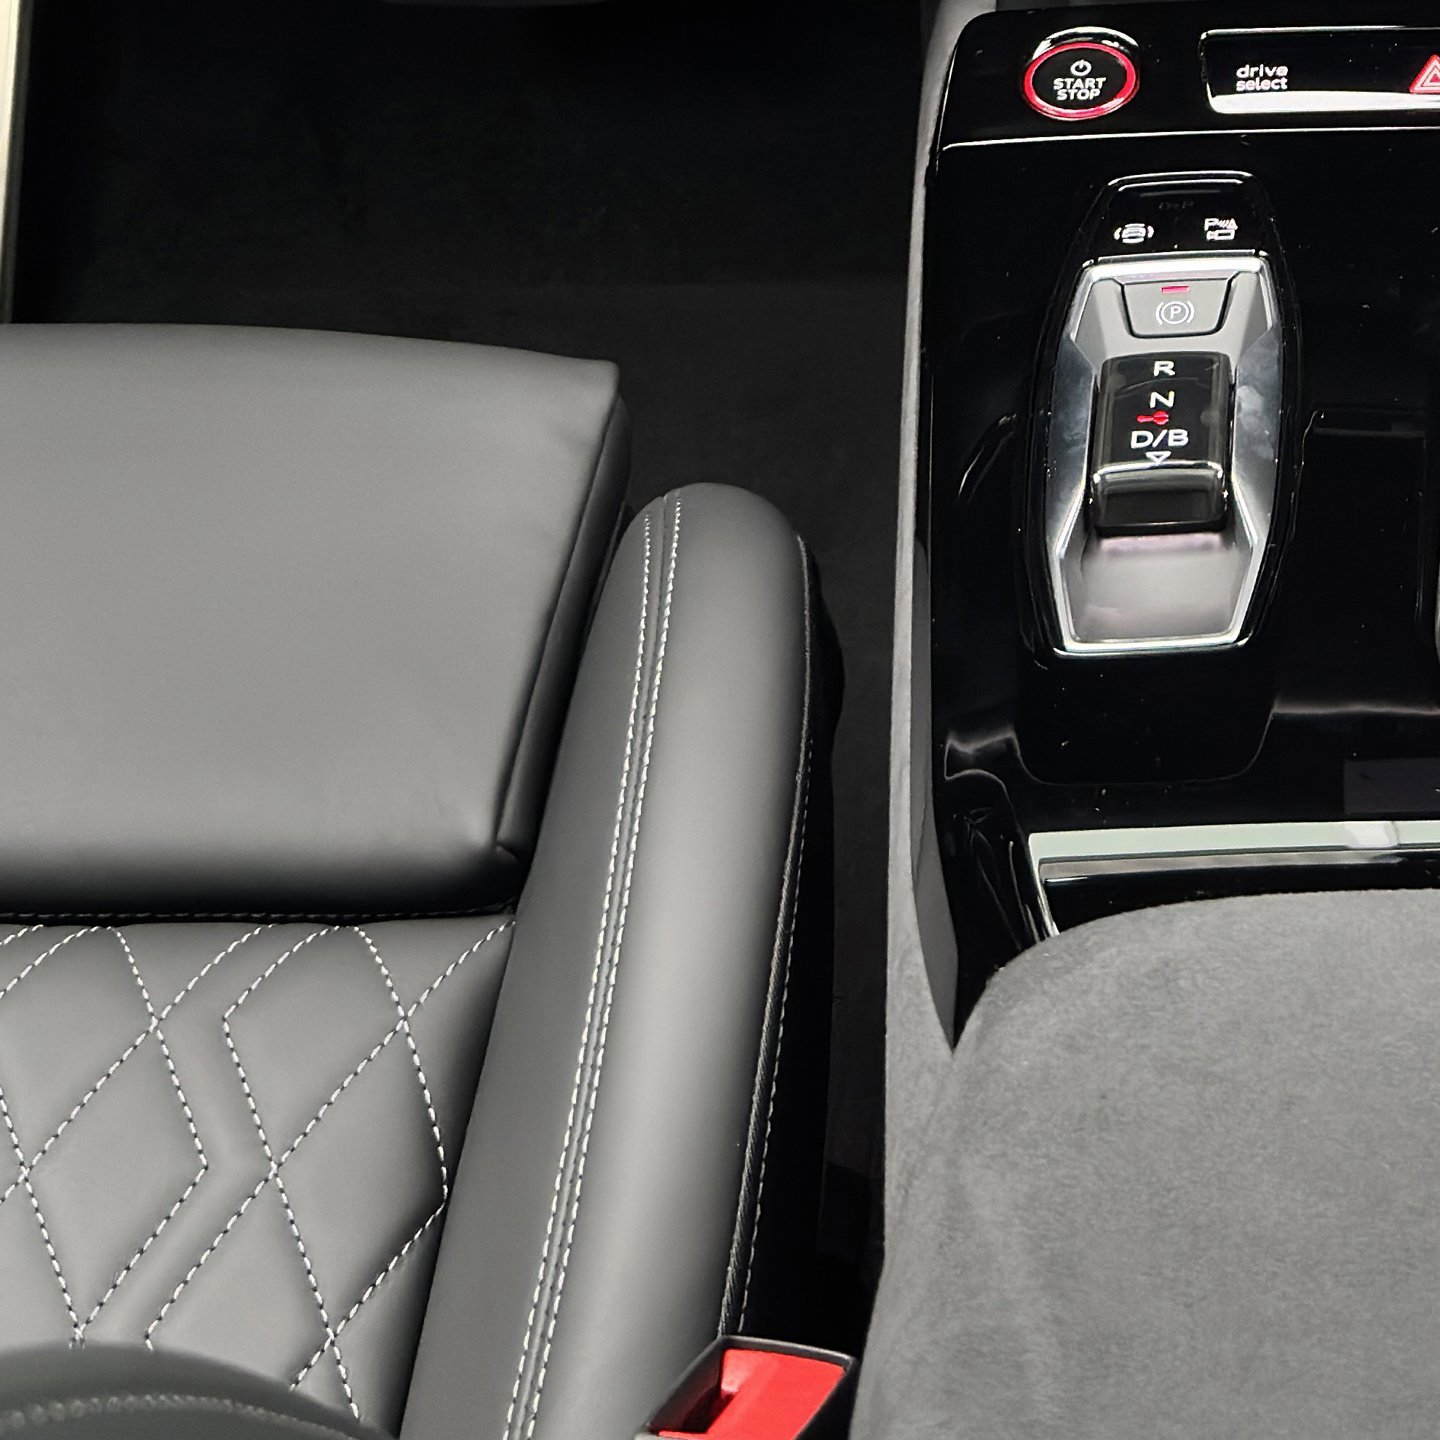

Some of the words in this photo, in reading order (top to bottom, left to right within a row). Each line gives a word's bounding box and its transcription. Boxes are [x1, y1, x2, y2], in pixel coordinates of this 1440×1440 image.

[1236, 64, 1289, 78] drive
[1053, 76, 1106, 90] START
[1236, 77, 1288, 91] select
[1057, 88, 1101, 101] STOP
[1153, 360, 1176, 376] R
[1149, 390, 1175, 408] N
[1131, 428, 1189, 449] D/B
